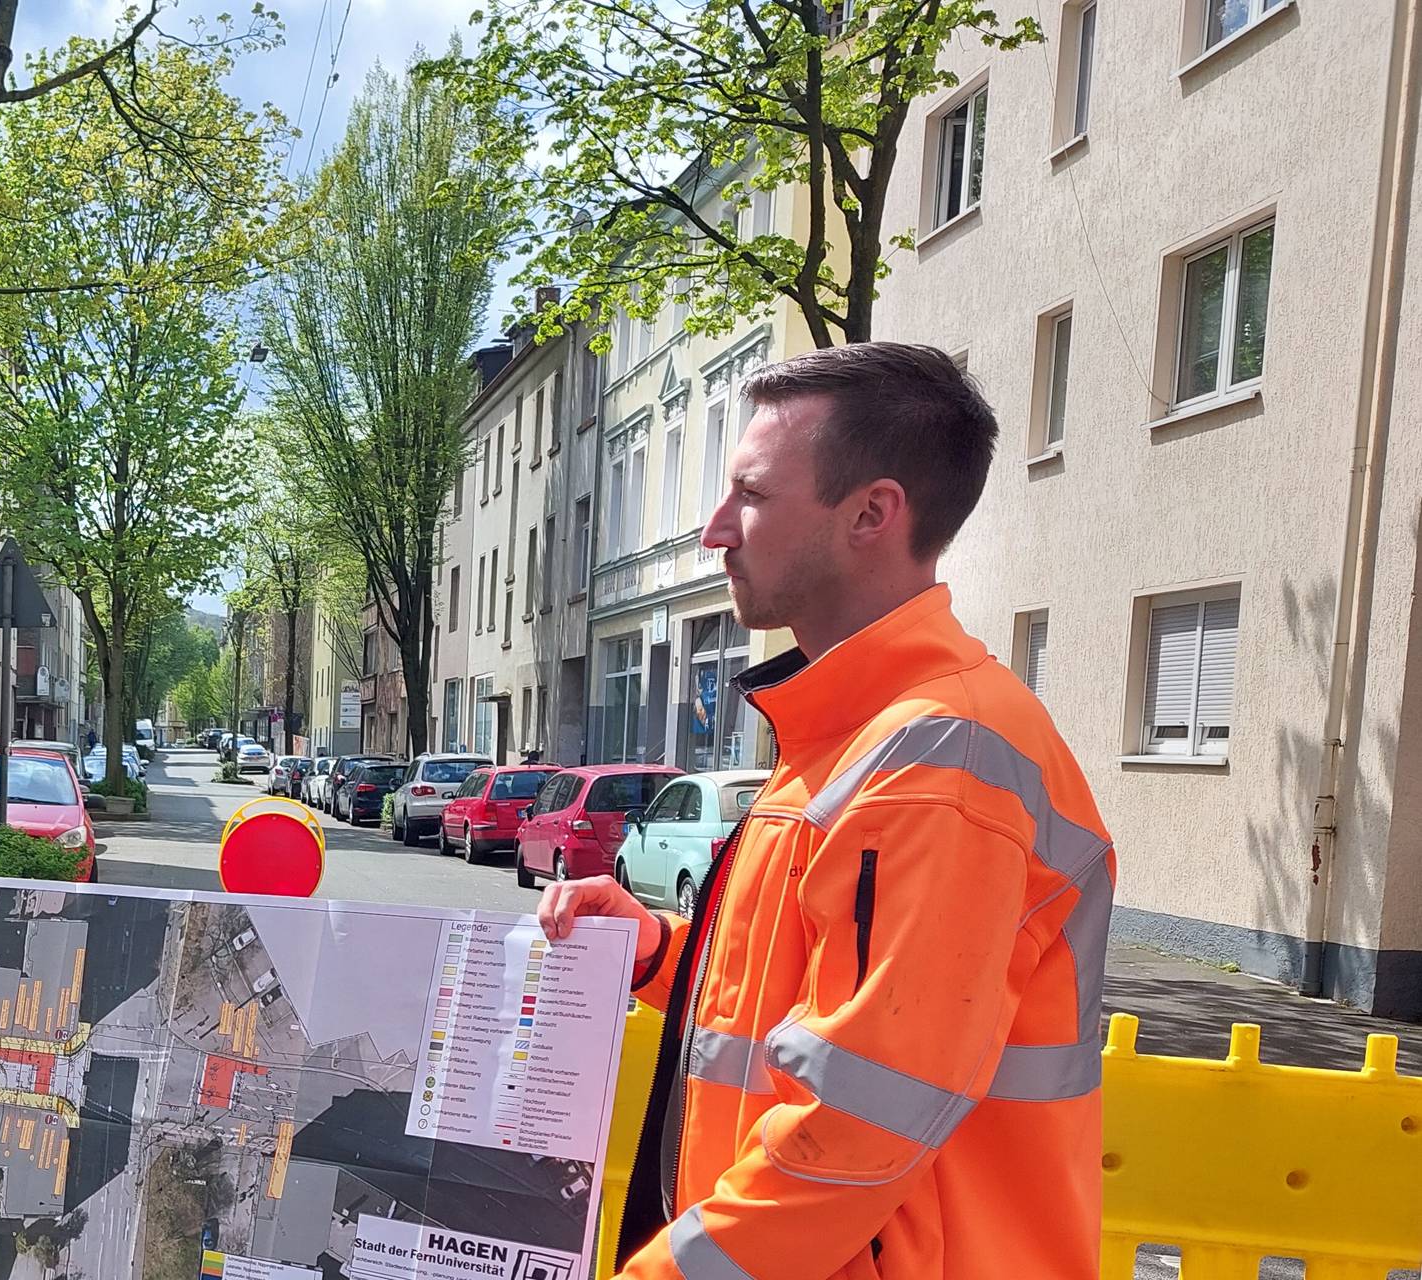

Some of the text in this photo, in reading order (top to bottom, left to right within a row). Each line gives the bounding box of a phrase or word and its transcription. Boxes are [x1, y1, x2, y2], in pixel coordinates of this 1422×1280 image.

[451, 921, 492, 933] Legende:
[354, 1237, 505, 1278] Stadt der FernUniversität
[428, 1233, 508, 1263] HAGEN
